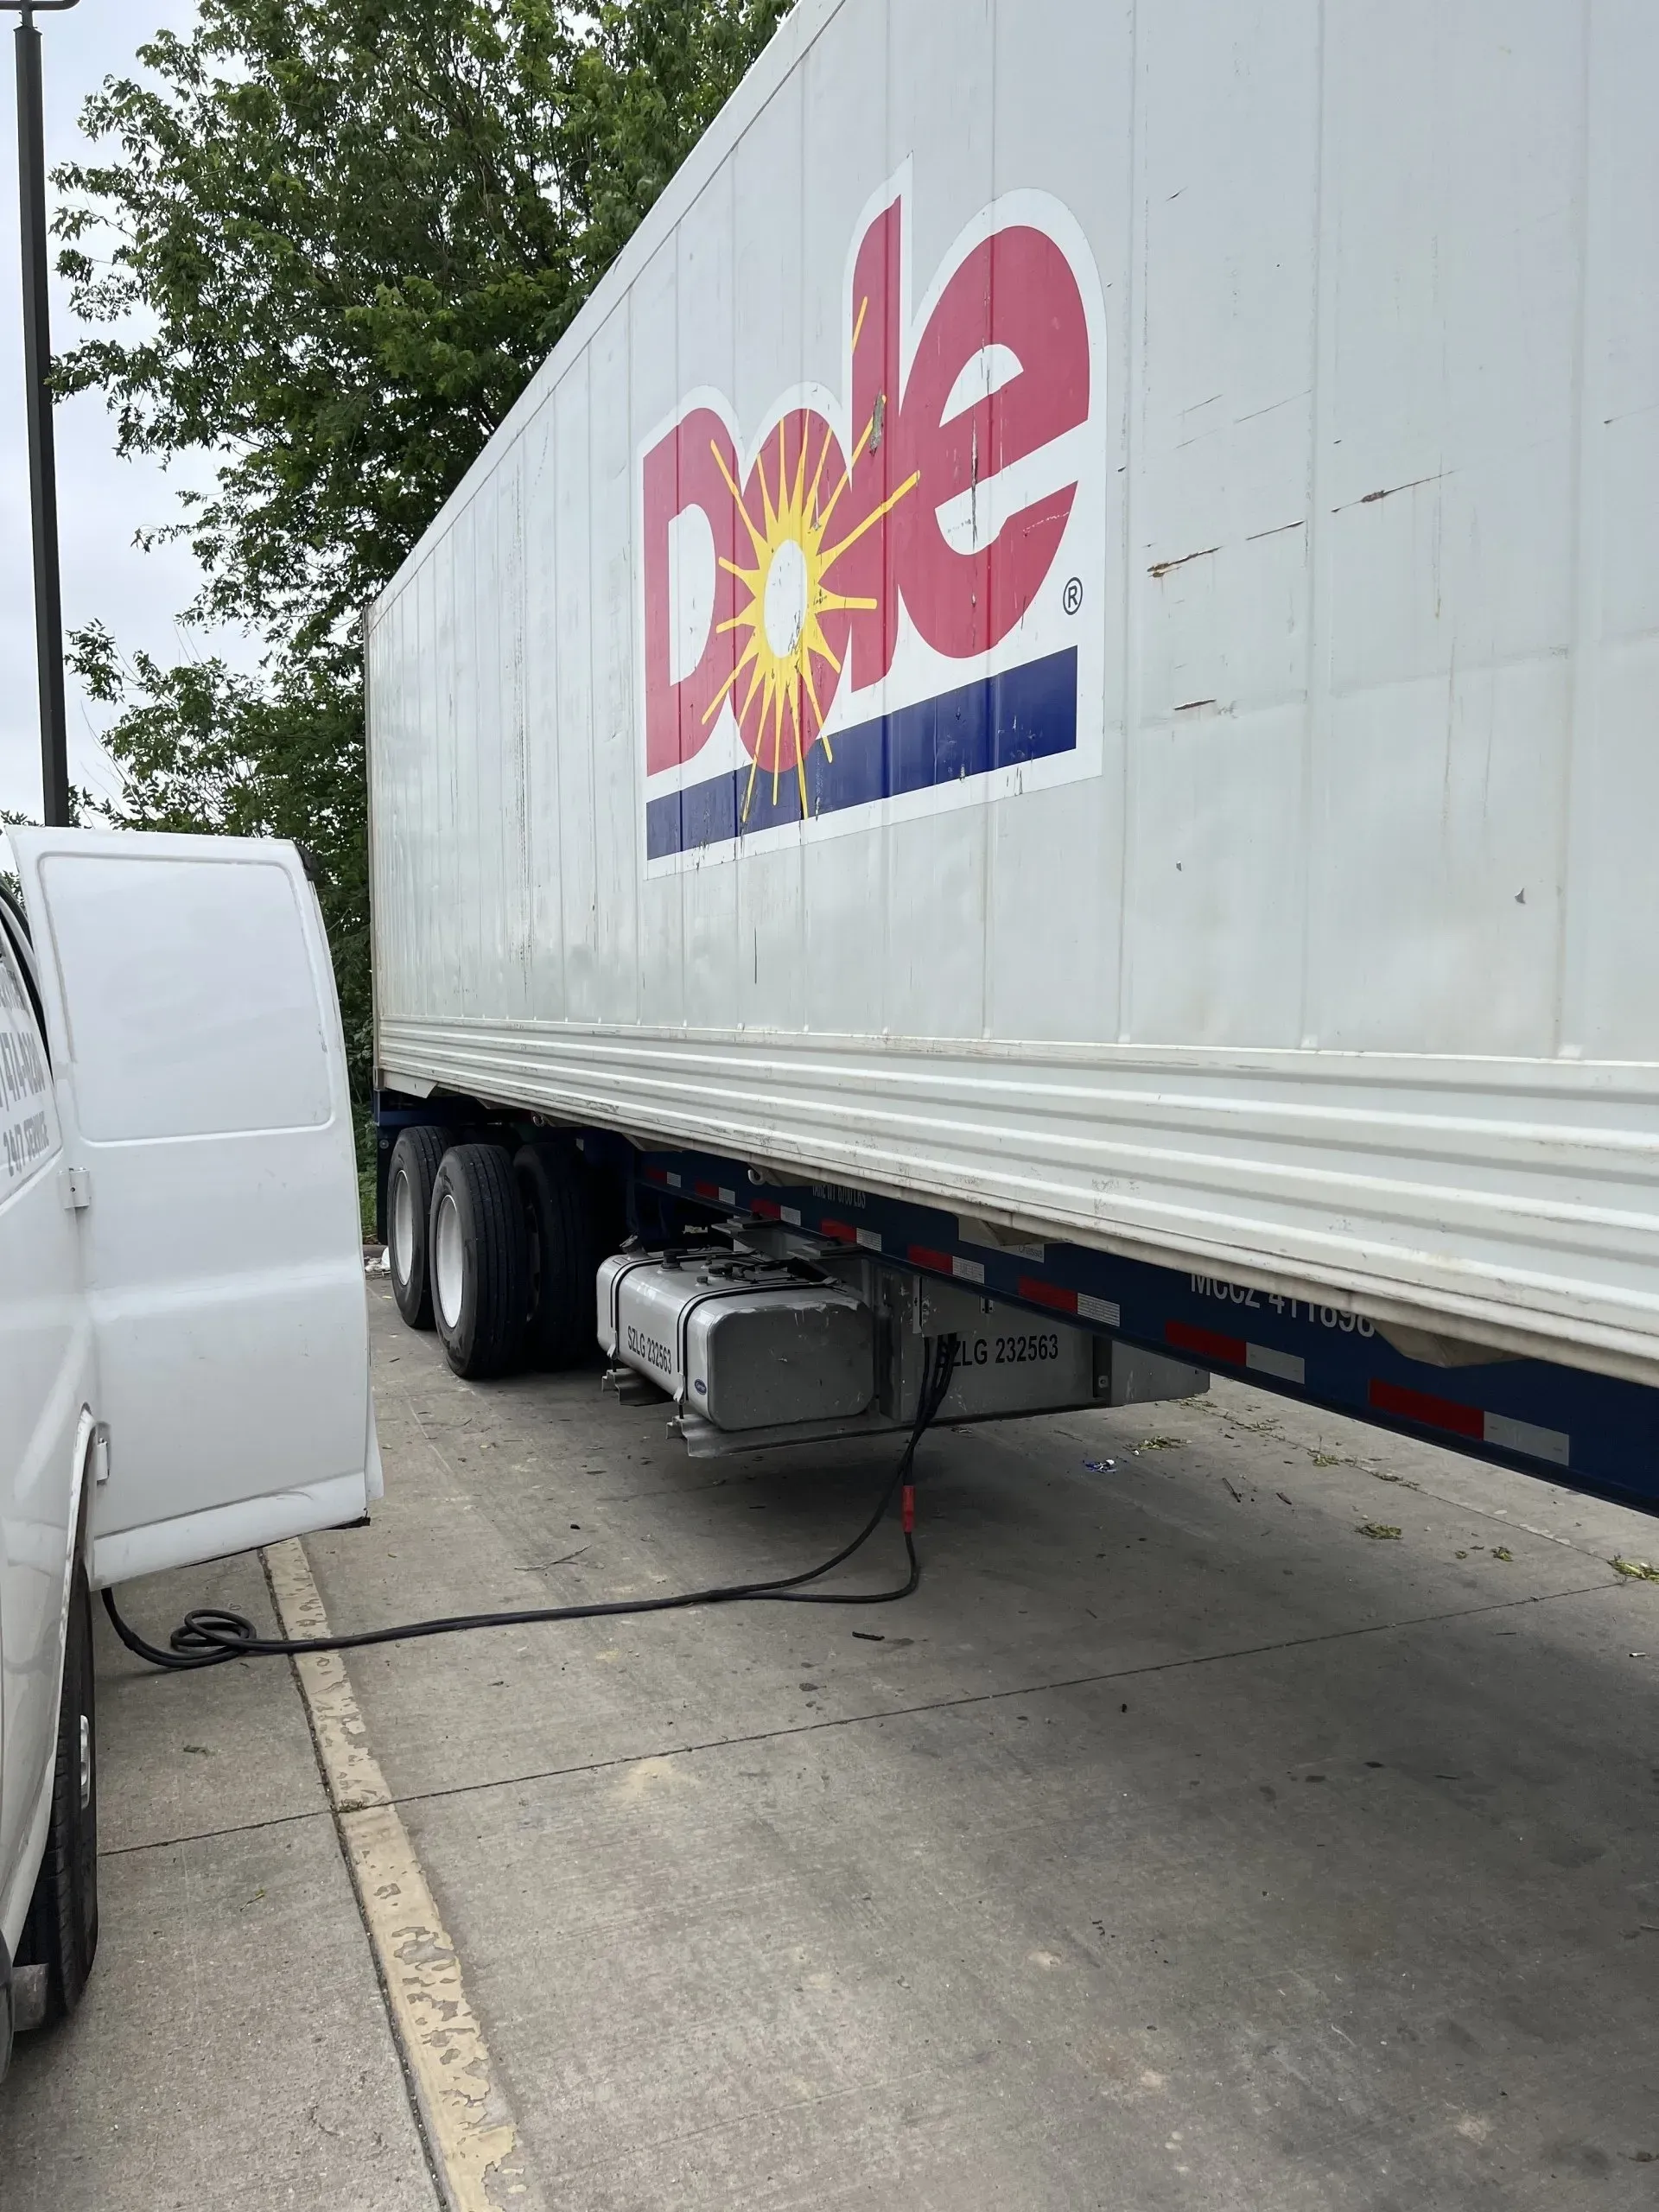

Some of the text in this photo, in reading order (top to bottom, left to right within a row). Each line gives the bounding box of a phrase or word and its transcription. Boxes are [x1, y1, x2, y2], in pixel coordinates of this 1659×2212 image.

[643, 194, 1090, 778] Dole
[627, 1325, 672, 1375] SZLG 232563
[938, 1333, 1058, 1367] ZLG 232563
